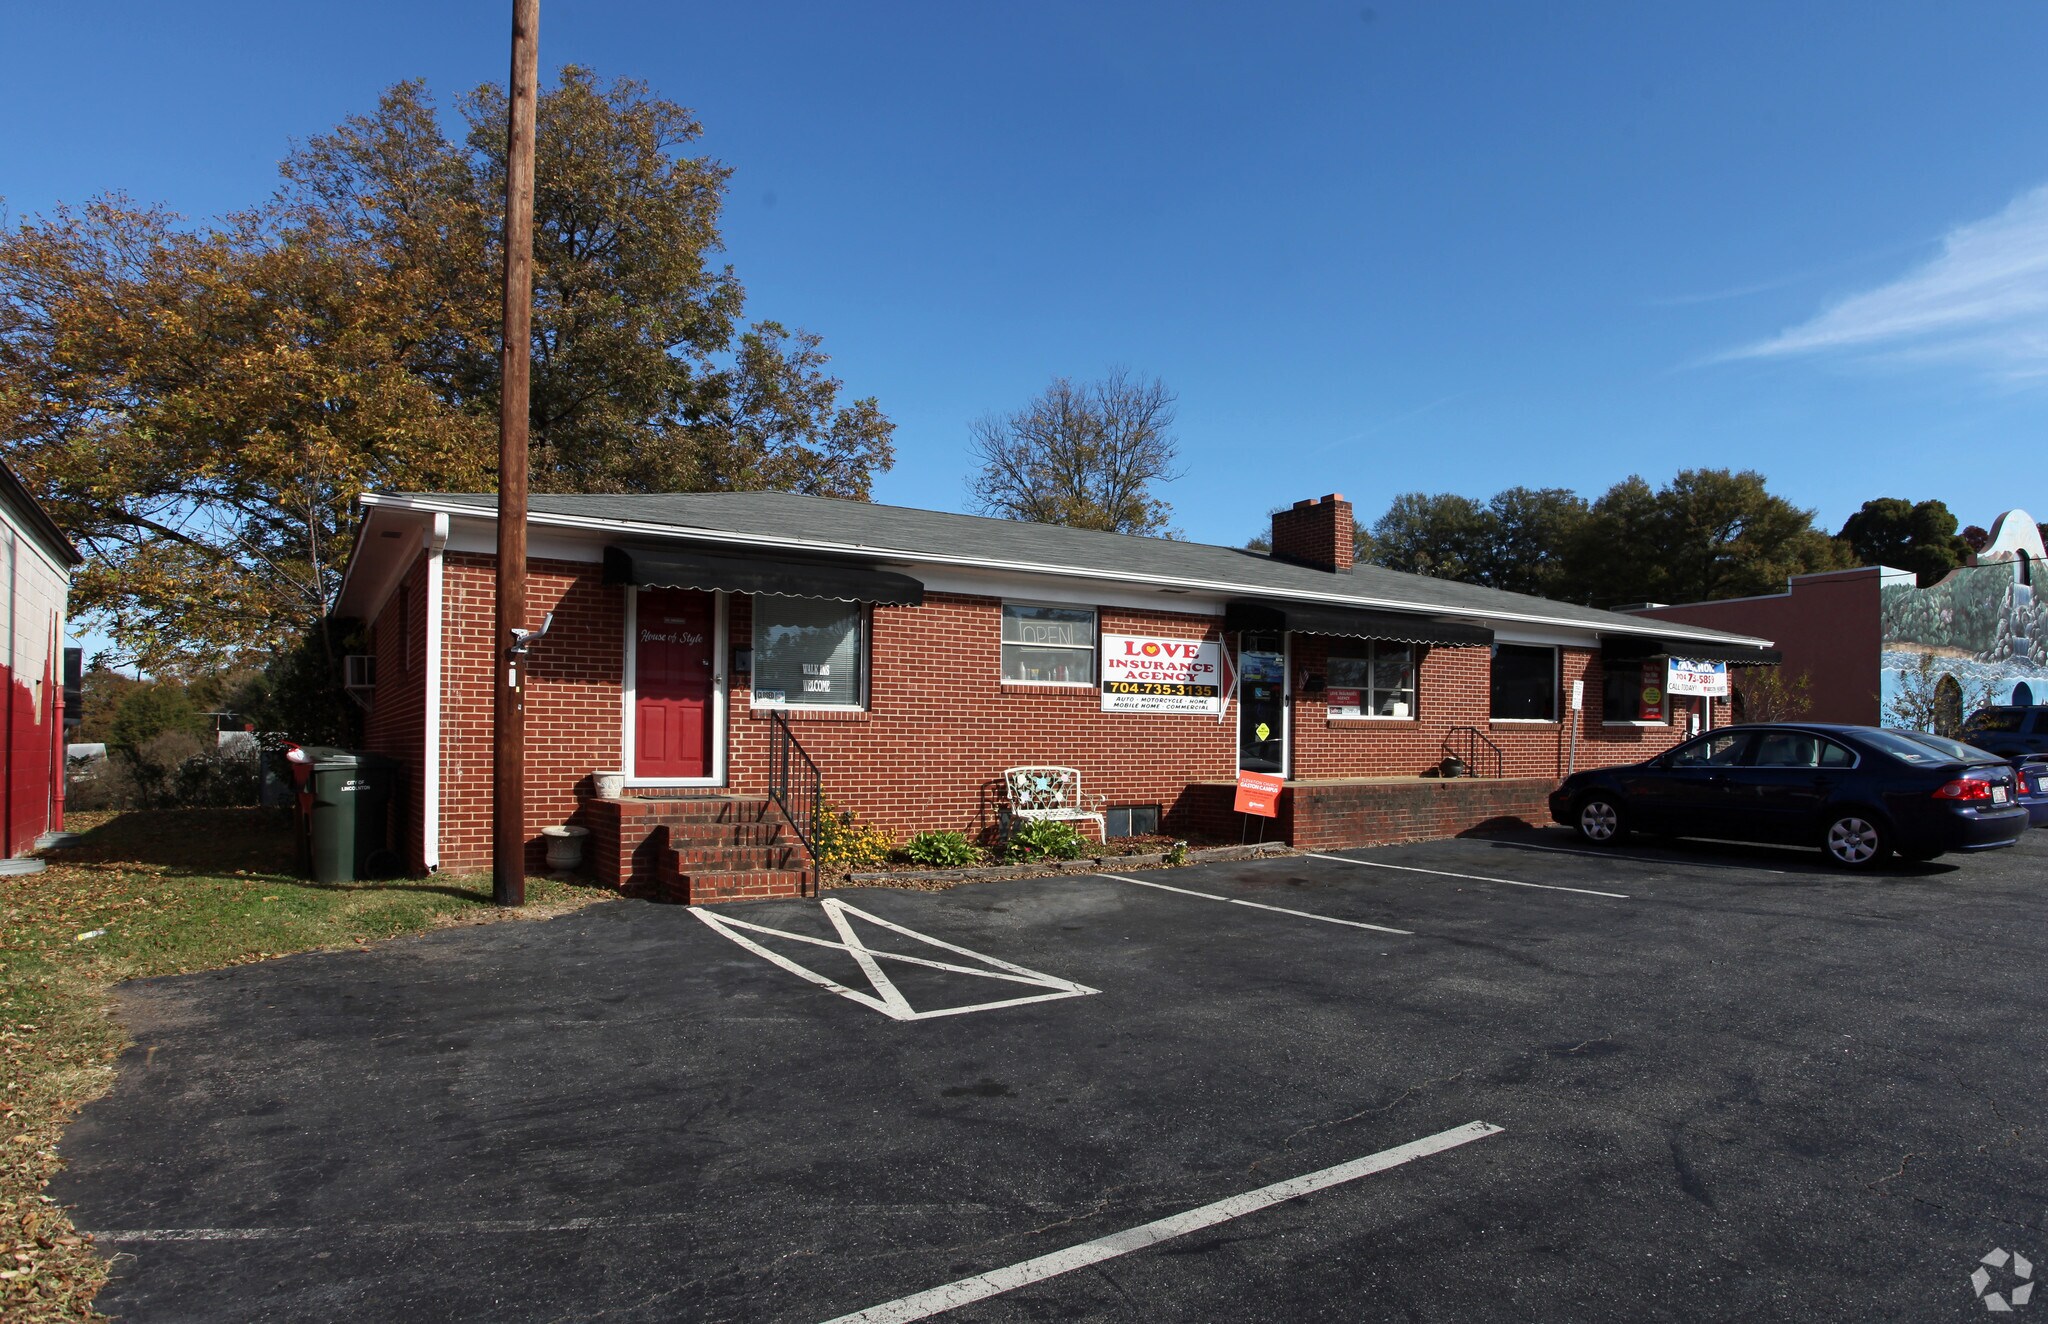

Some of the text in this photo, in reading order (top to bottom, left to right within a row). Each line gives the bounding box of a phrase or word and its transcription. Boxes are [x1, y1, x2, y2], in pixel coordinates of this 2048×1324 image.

[640, 629, 703, 646] House of Style
[1022, 625, 1071, 646] OPEN
[1124, 641, 1199, 659] LOVE
[1109, 659, 1214, 672] INSURANCE
[1125, 670, 1199, 682] AGENCY
[802, 680, 831, 692] WELCOME
[1110, 682, 1212, 697] 704-735-3135
[1668, 683, 1680, 691] CALL
